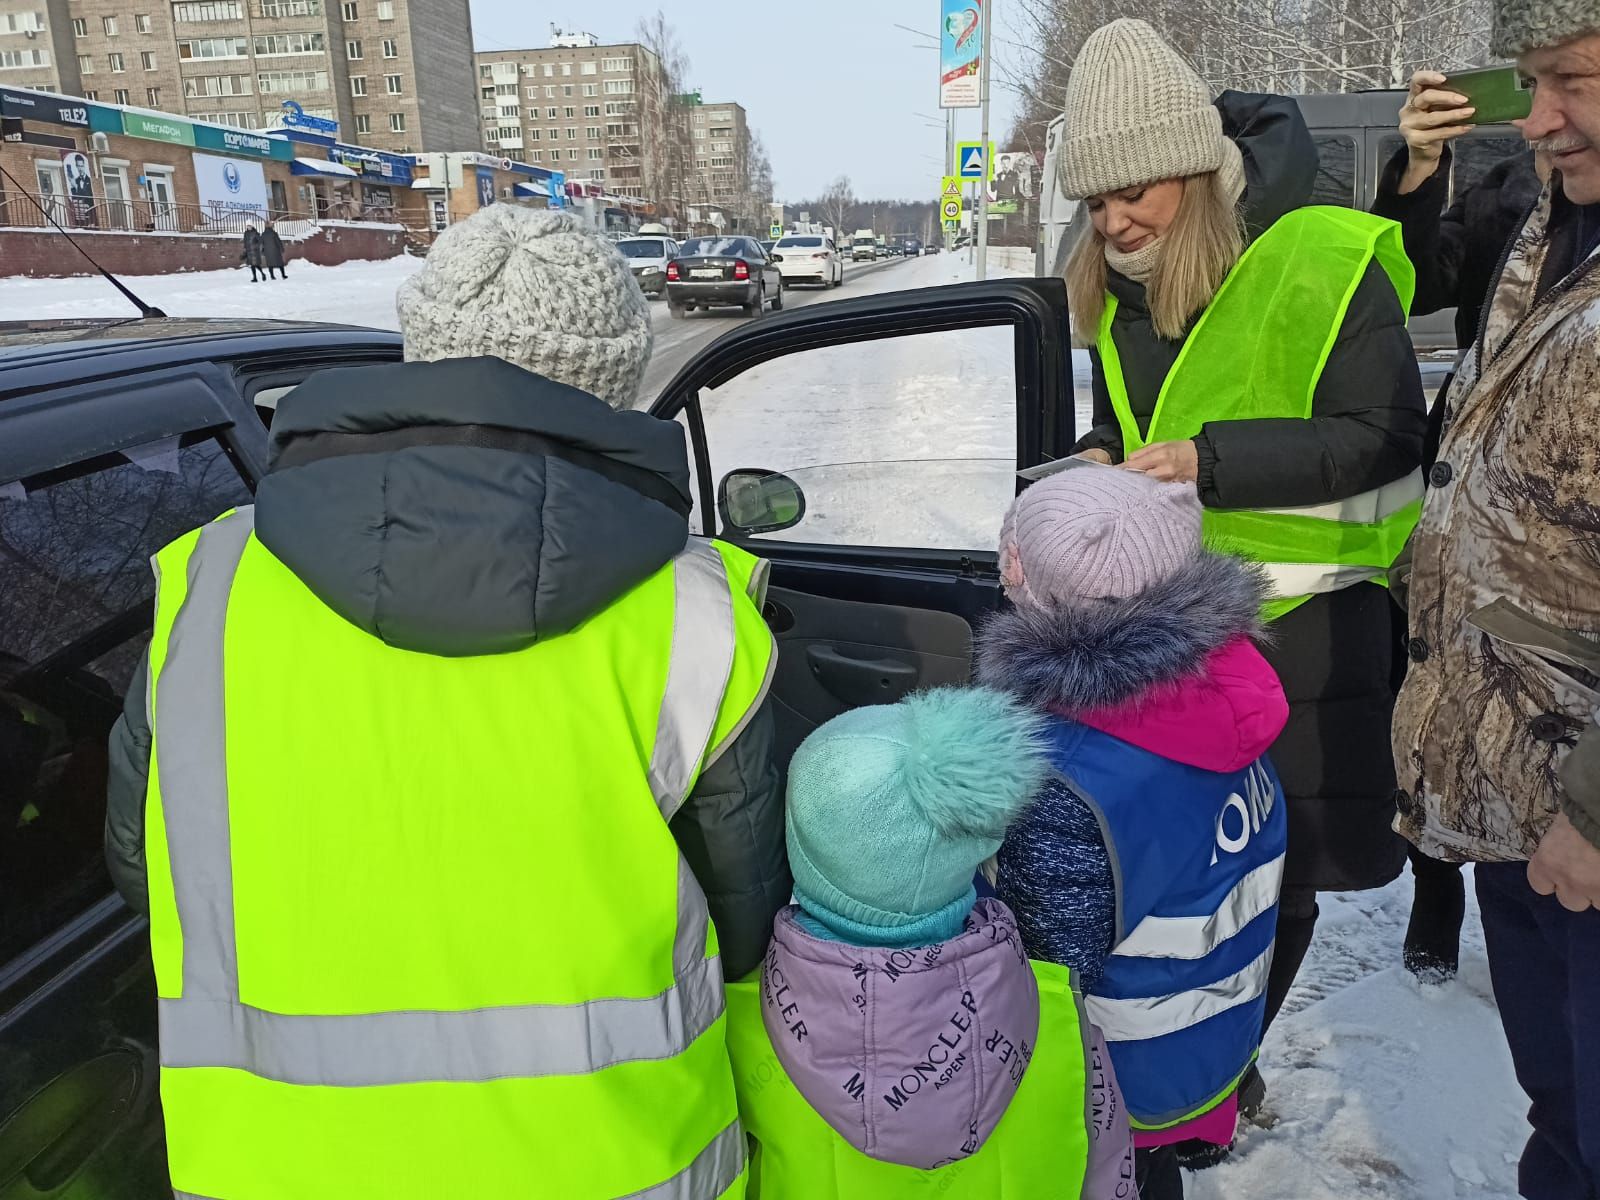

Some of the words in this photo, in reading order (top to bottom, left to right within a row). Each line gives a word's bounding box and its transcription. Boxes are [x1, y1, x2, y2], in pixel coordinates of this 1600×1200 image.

[58, 107, 89, 125] TELE2
[4, 132, 23, 142] TELE2
[883, 990, 977, 1112] MONCLER
[934, 1052, 966, 1091] ASPEN
